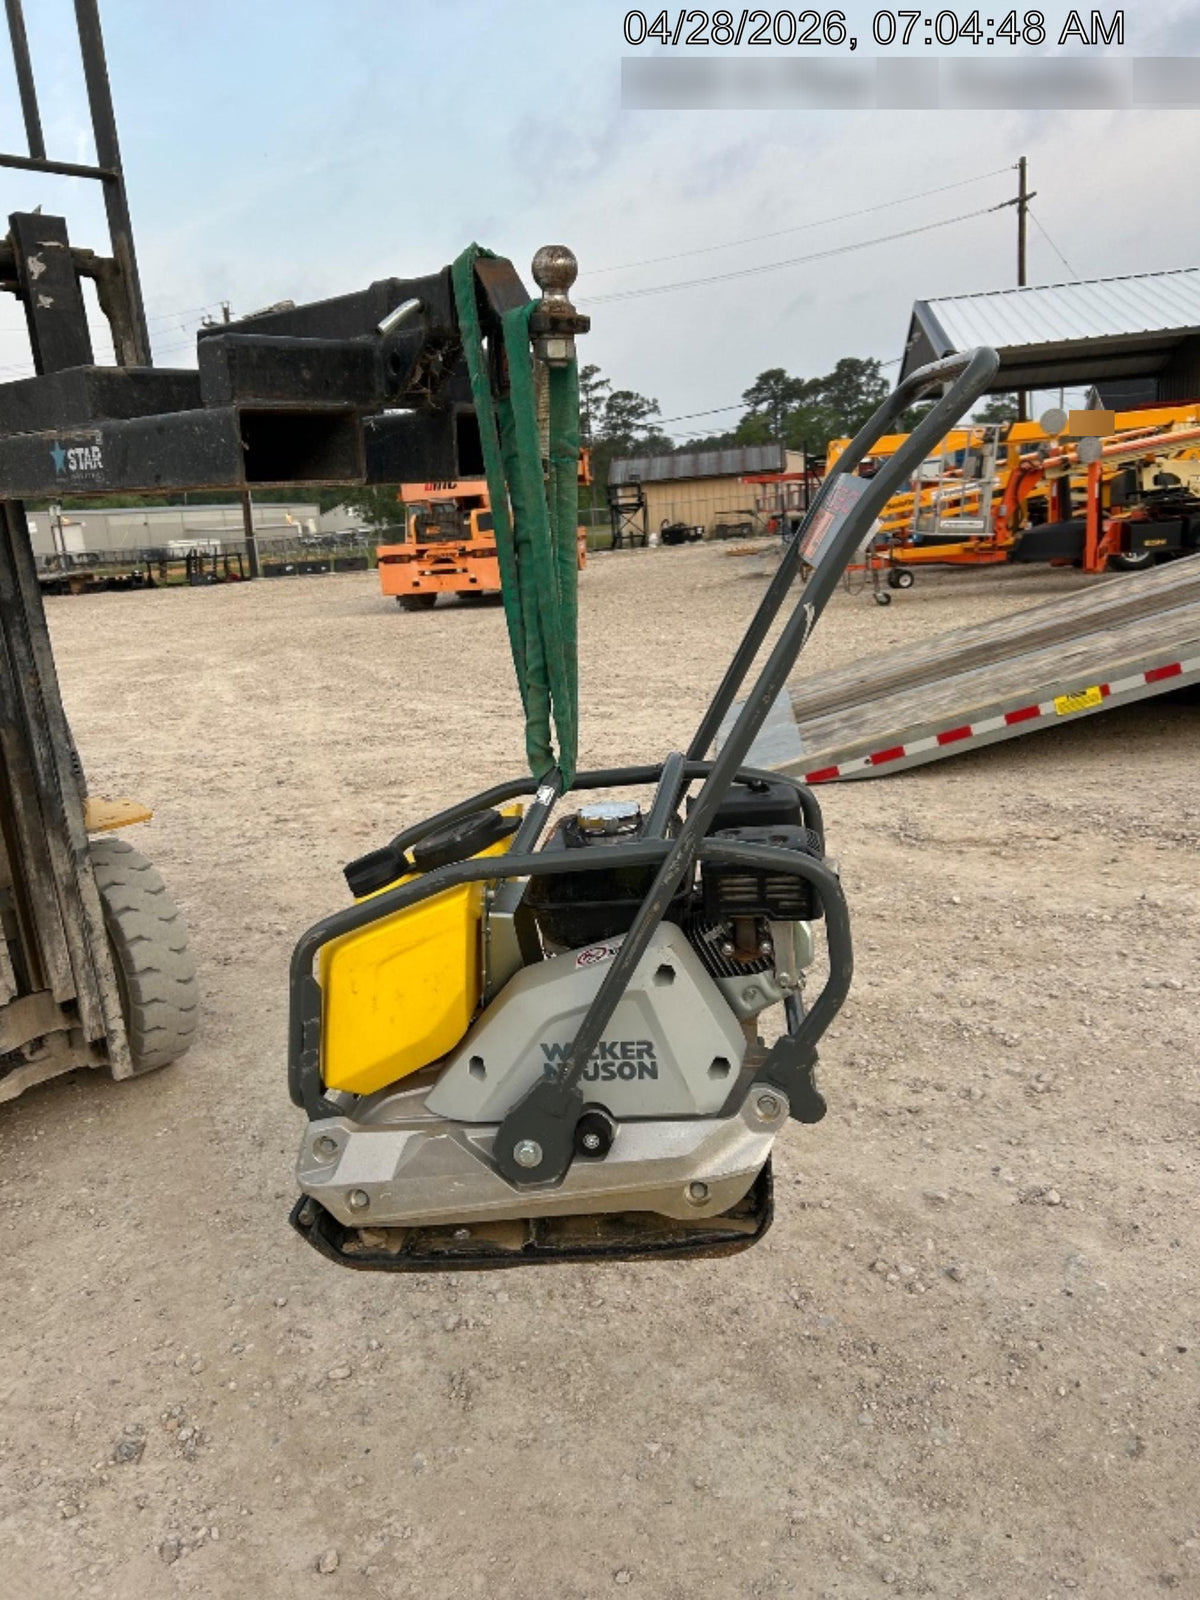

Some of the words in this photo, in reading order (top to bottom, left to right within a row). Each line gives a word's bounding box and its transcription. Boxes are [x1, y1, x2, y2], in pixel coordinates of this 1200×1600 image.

[67, 446, 103, 471] STAR
[540, 1040, 657, 1061] WKER
[543, 1060, 659, 1082] NUSON
